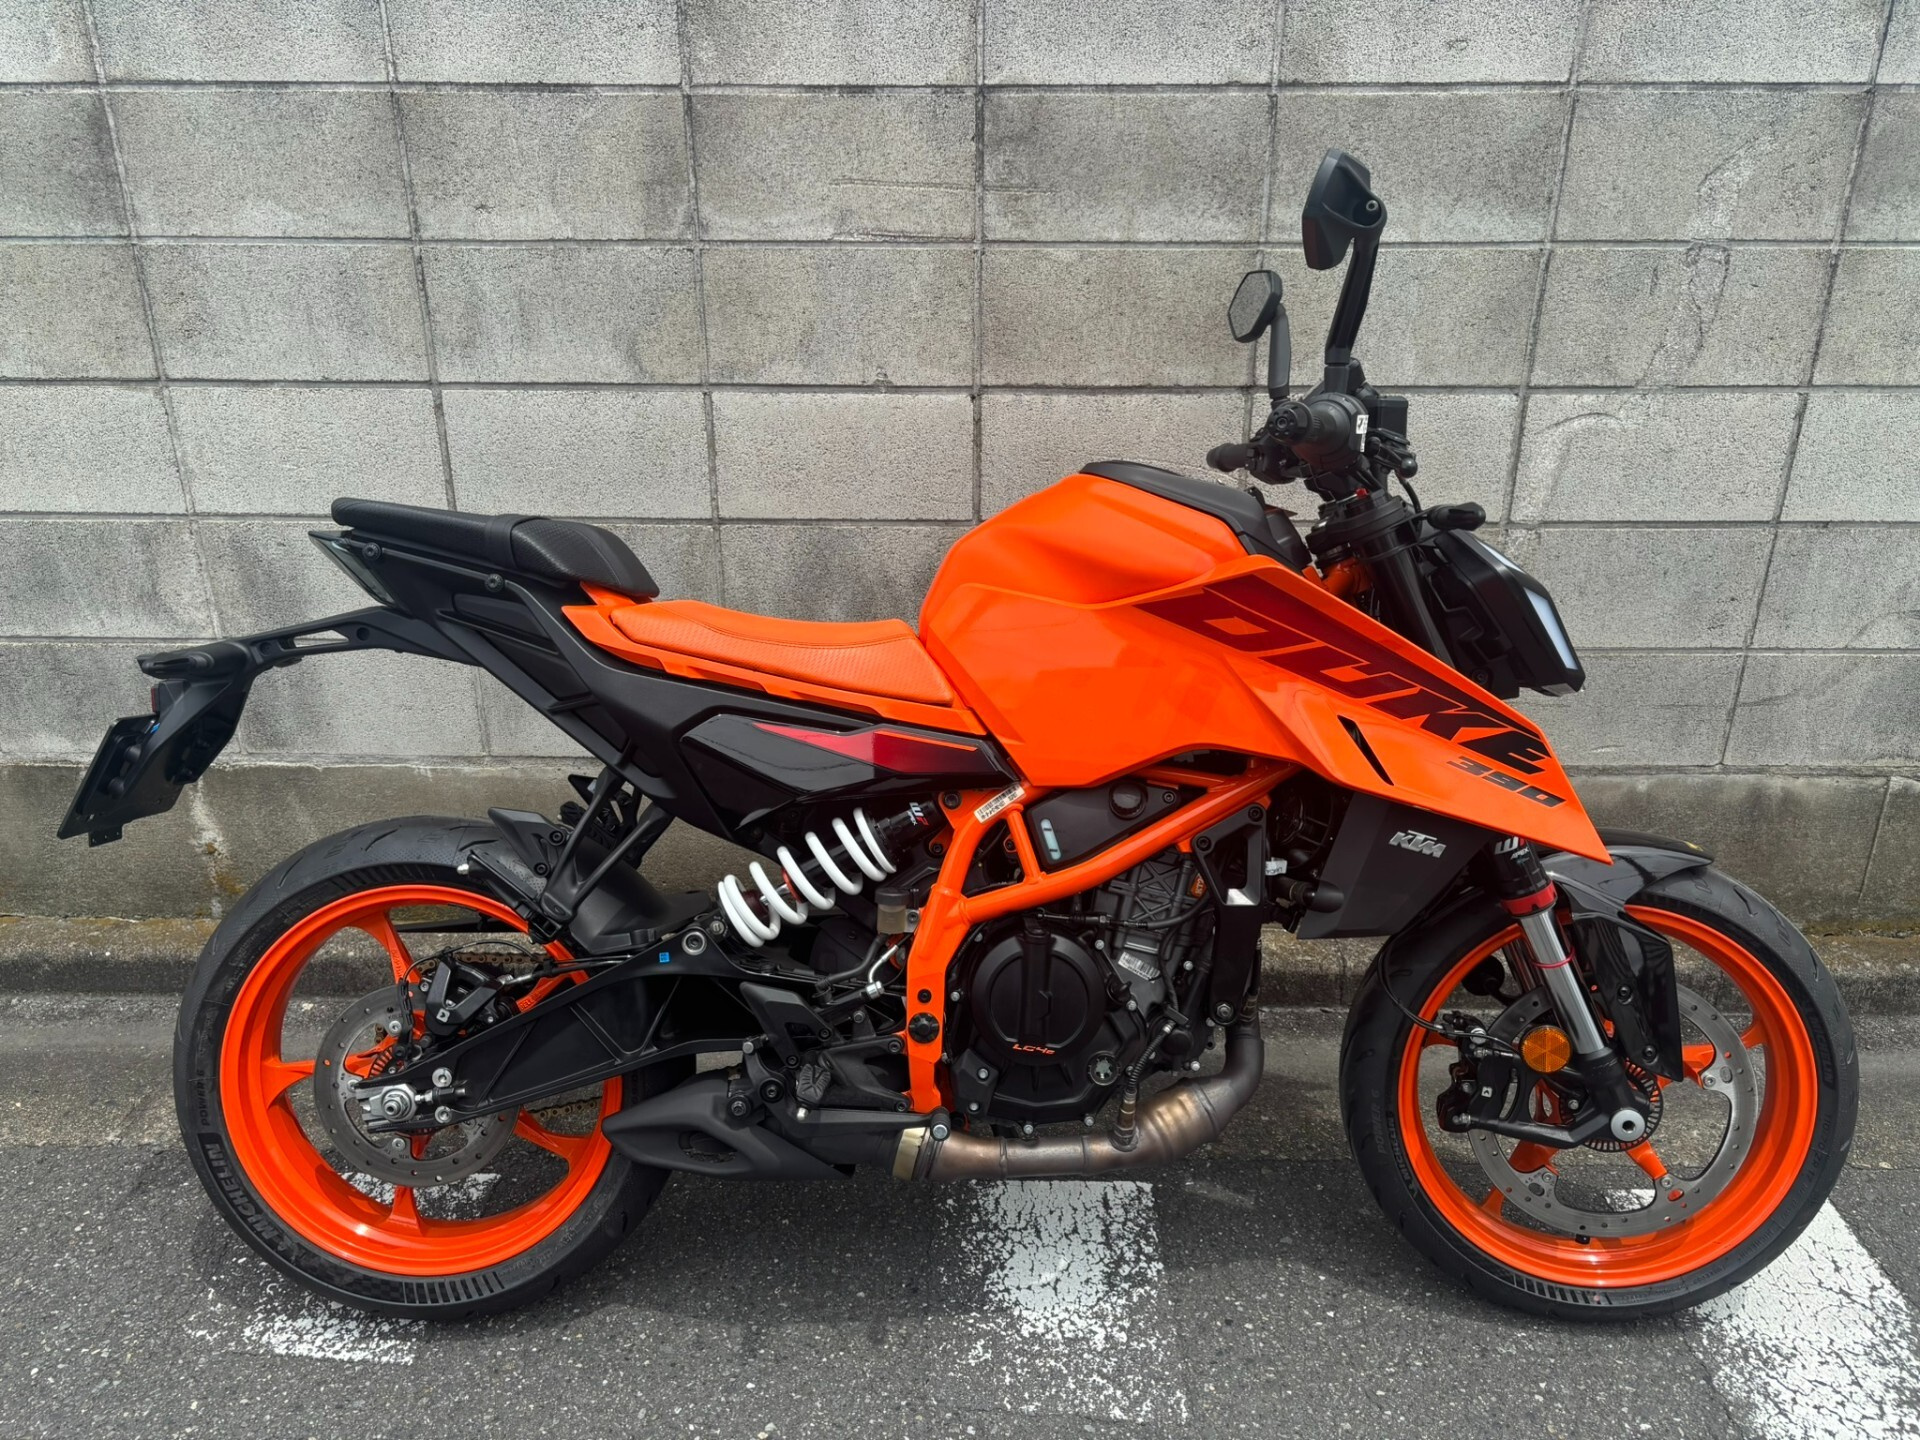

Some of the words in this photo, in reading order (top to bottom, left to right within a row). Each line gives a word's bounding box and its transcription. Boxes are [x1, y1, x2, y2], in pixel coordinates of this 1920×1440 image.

[1132, 588, 1552, 775] DUKE
[1446, 756, 1567, 808] 390
[1389, 829, 1447, 858] KTM
[205, 1143, 279, 1241] MICHELIN
